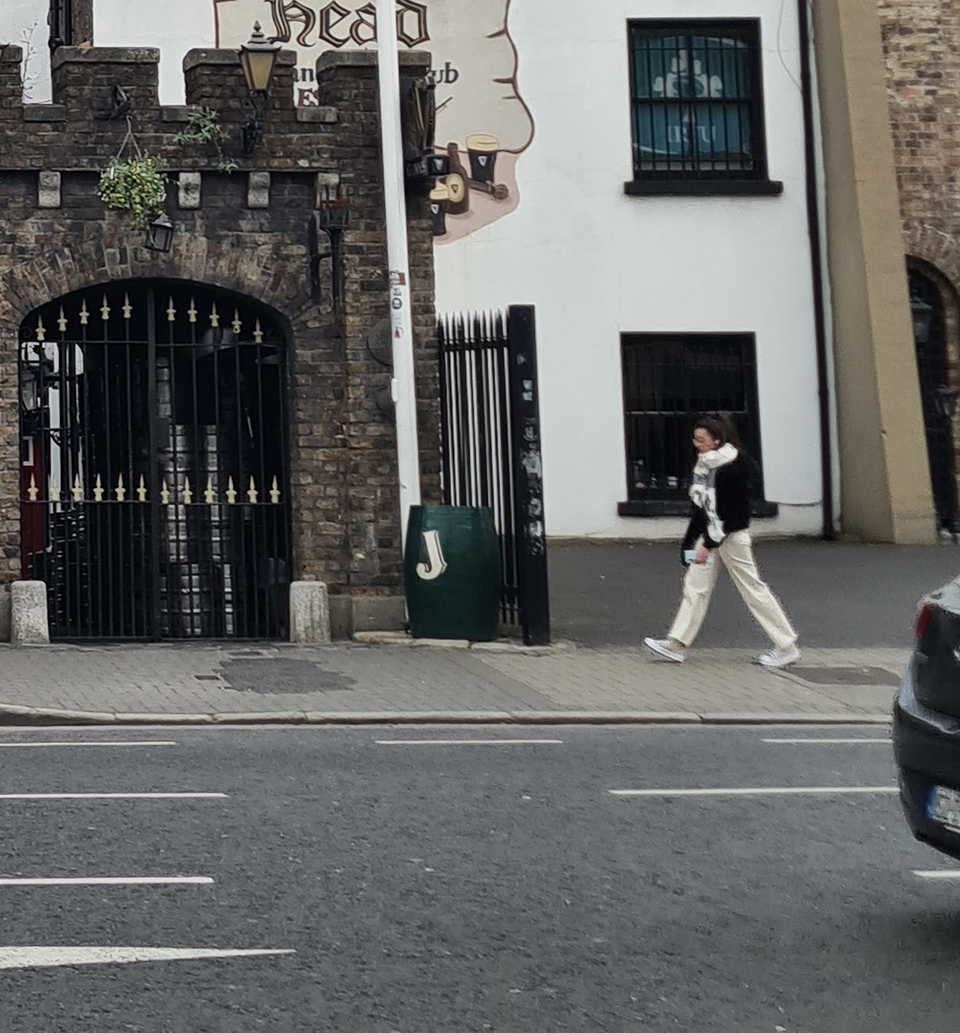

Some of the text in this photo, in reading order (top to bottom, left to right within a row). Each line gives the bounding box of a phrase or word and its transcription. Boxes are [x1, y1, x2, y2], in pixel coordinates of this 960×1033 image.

[430, 62, 459, 84] ub
[667, 125, 717, 143] IRU
[416, 529, 448, 580] J
